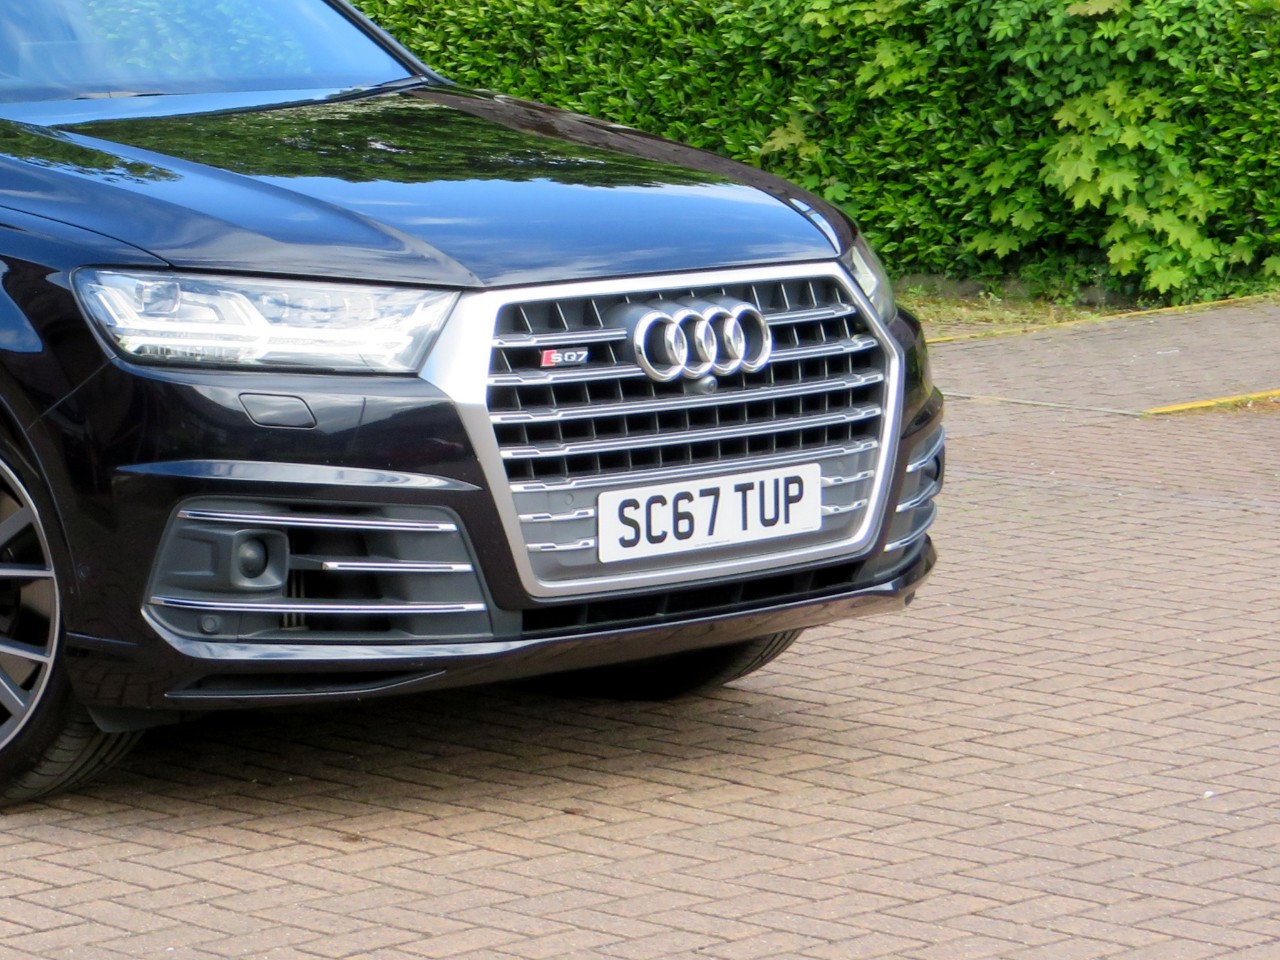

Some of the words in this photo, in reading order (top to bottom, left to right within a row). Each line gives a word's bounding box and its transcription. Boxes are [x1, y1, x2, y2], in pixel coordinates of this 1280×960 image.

[550, 351, 589, 363] SQ7
[618, 486, 721, 549] SC67
[734, 475, 805, 531] TUP
